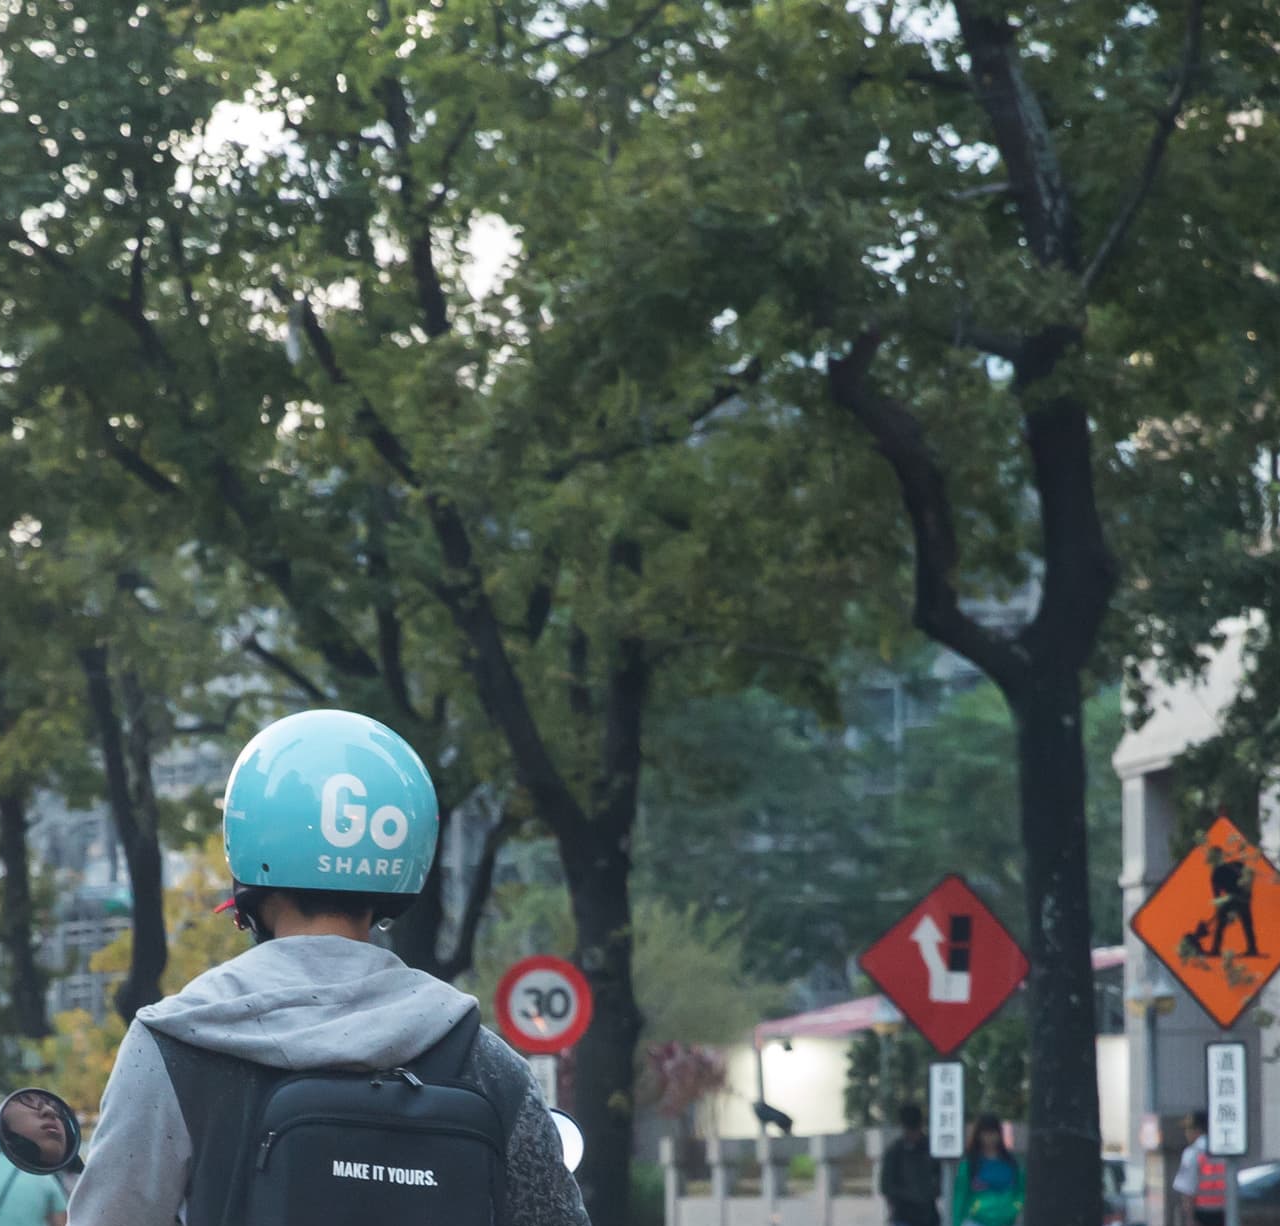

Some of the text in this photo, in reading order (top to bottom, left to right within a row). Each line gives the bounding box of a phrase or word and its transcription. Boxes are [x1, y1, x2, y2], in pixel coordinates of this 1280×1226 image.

[320, 772, 408, 850] Go
[317, 854, 404, 876] SHARE
[521, 986, 571, 1020] 30
[332, 1160, 438, 1186] MAKE IT YOURS.
